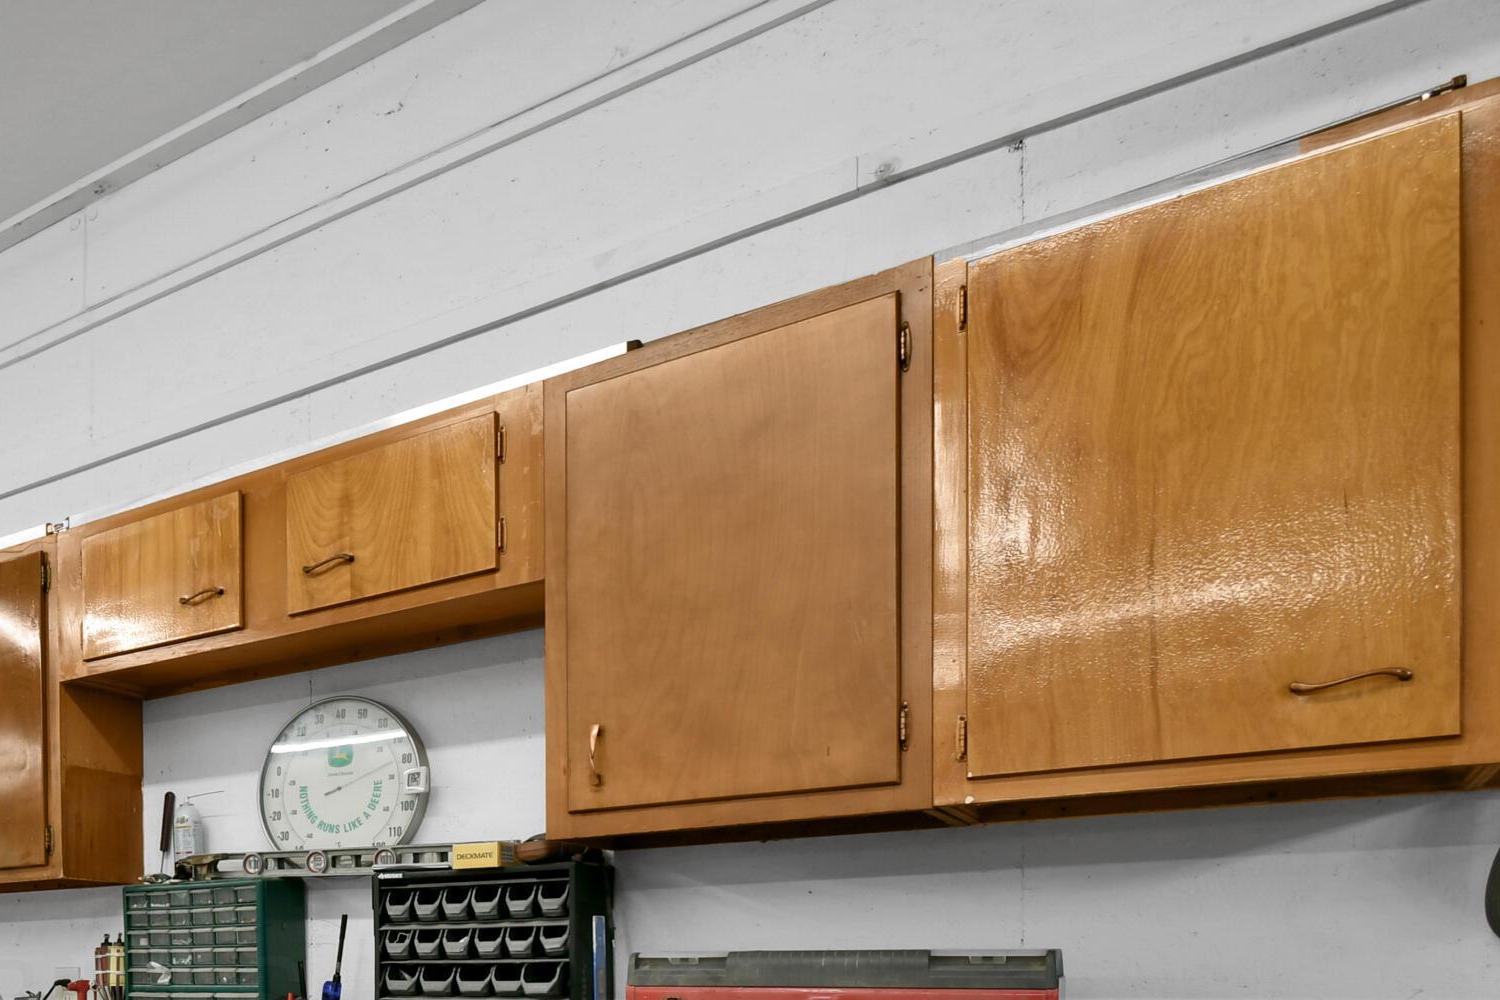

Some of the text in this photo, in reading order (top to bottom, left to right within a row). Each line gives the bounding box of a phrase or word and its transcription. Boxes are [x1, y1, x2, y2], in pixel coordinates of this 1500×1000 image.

[315, 714, 324, 724] 30
[336, 709, 346, 719] 40
[358, 709, 368, 719] 50
[402, 753, 412, 764] 80
[267, 788, 280, 798] -10
[299, 779, 383, 834] NOTHING RUNS LIKE A DEERE
[400, 801, 414, 812] 100
[269, 811, 282, 821] -20
[277, 831, 290, 841] -30
[389, 826, 403, 838] 110
[456, 852, 493, 861] DECKMATE
